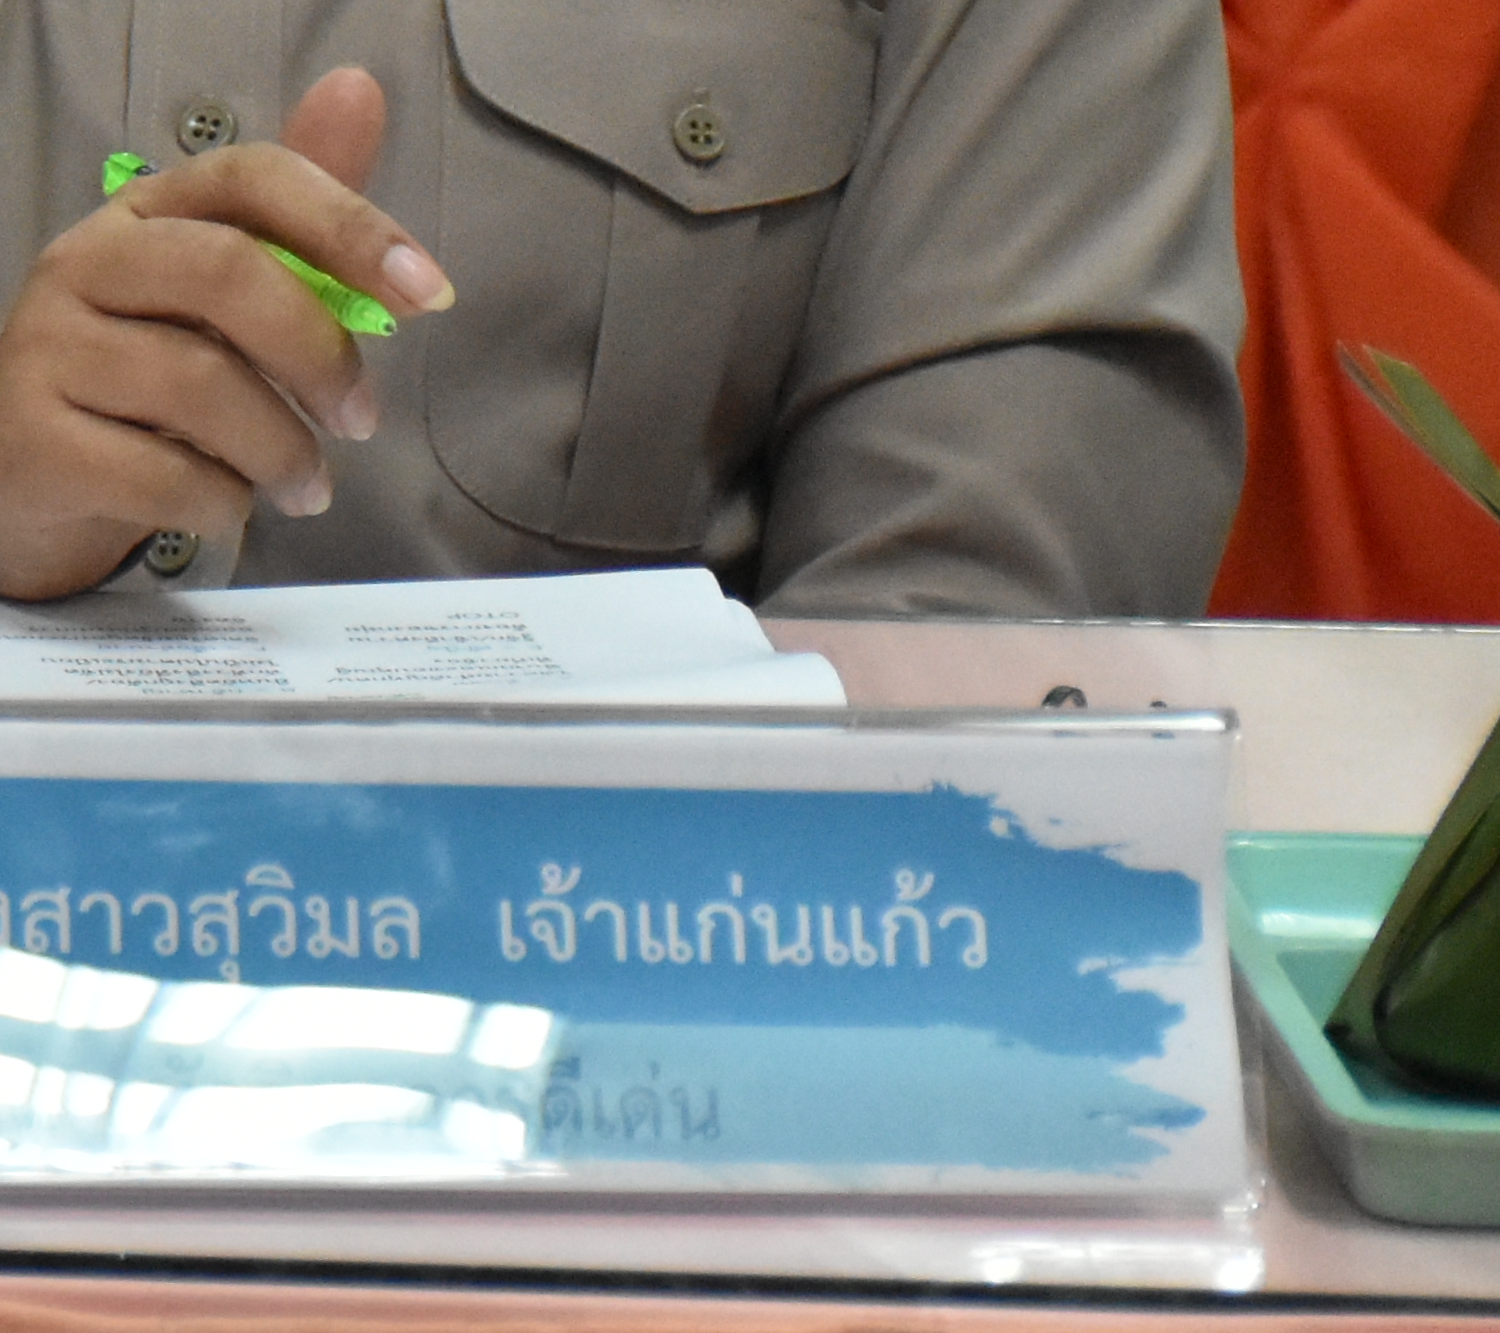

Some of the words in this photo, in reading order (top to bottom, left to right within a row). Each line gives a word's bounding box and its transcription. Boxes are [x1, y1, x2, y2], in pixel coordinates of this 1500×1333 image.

[498, 862, 989, 969] เจ้าแก่นแก้ว
